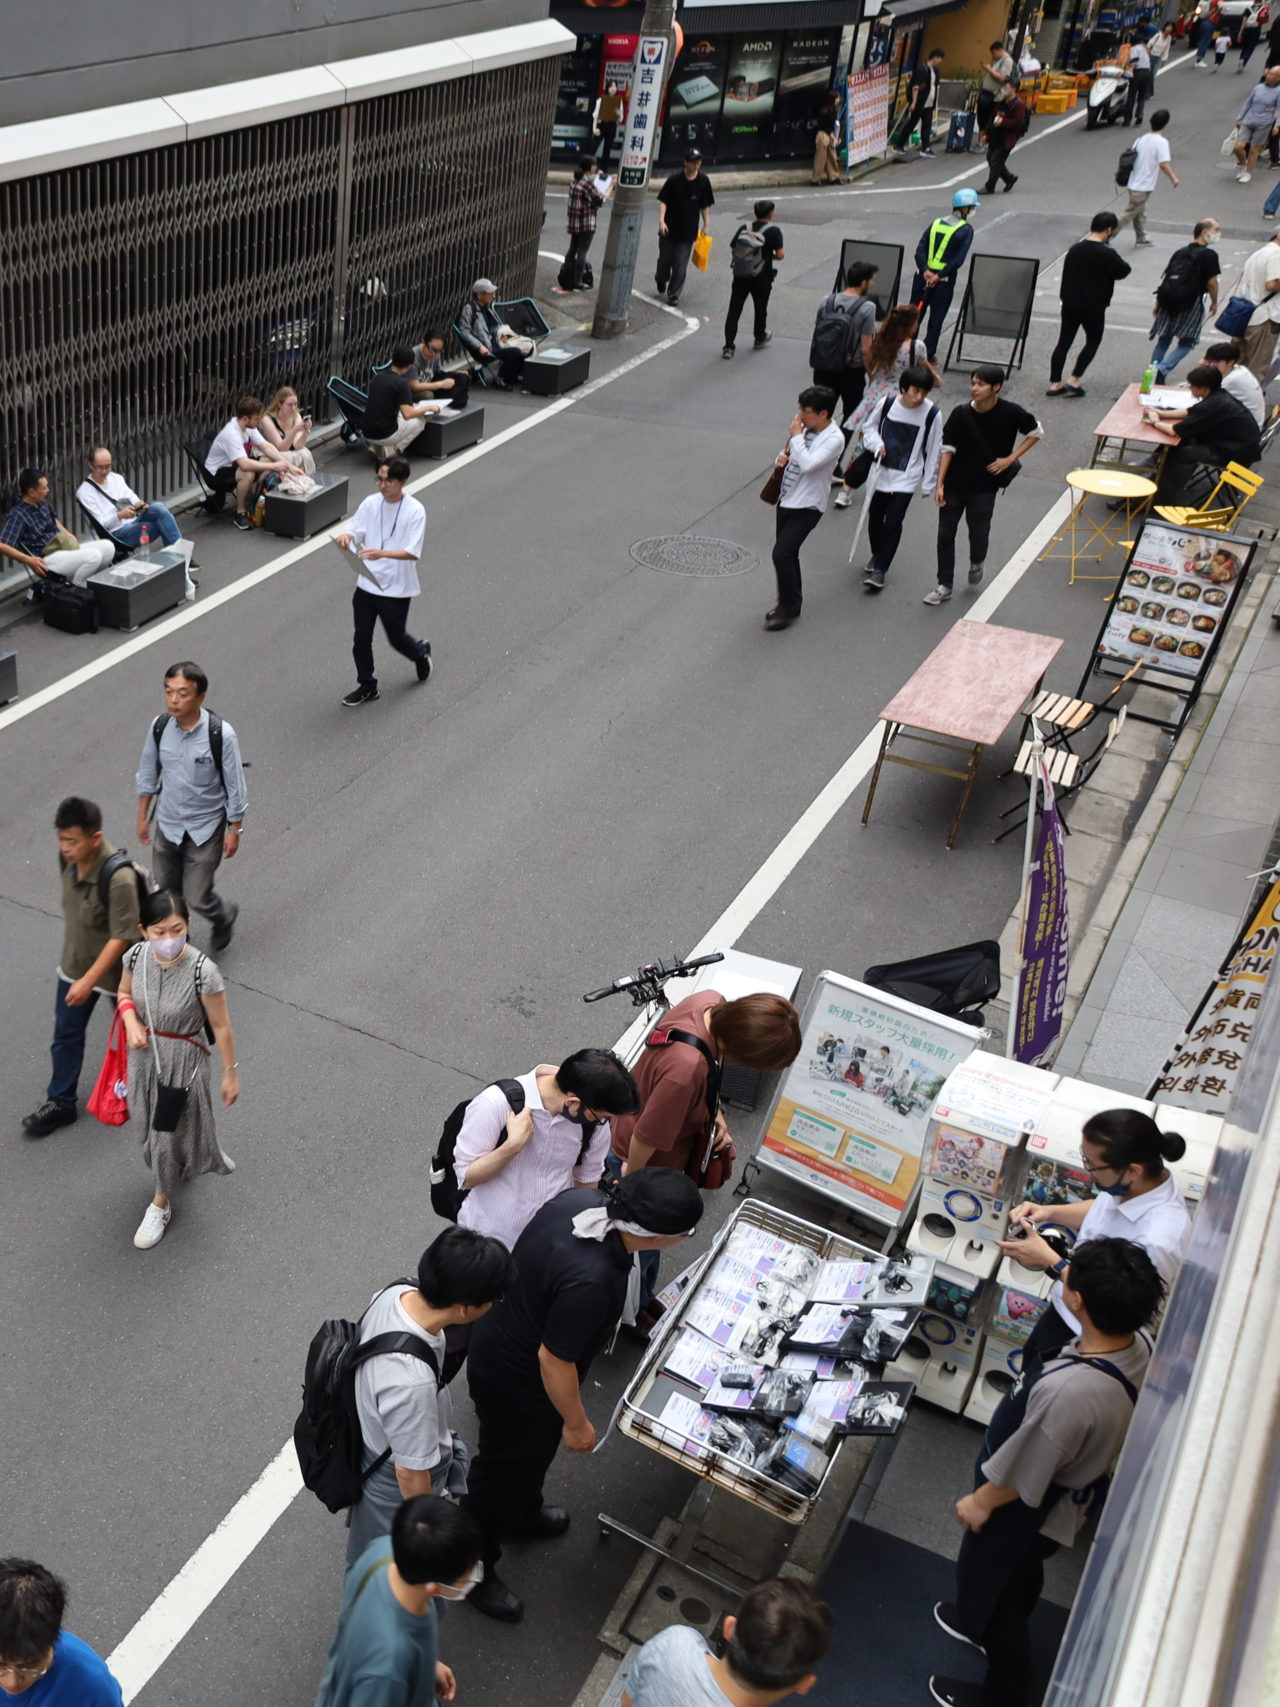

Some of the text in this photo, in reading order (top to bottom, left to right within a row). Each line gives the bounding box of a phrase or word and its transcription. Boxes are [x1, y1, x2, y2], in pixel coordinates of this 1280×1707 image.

[793, 40, 830, 48] RADEON
[630, 68, 656, 151] 吉井歯科
[1160, 1074, 1229, 1097] 외화환
